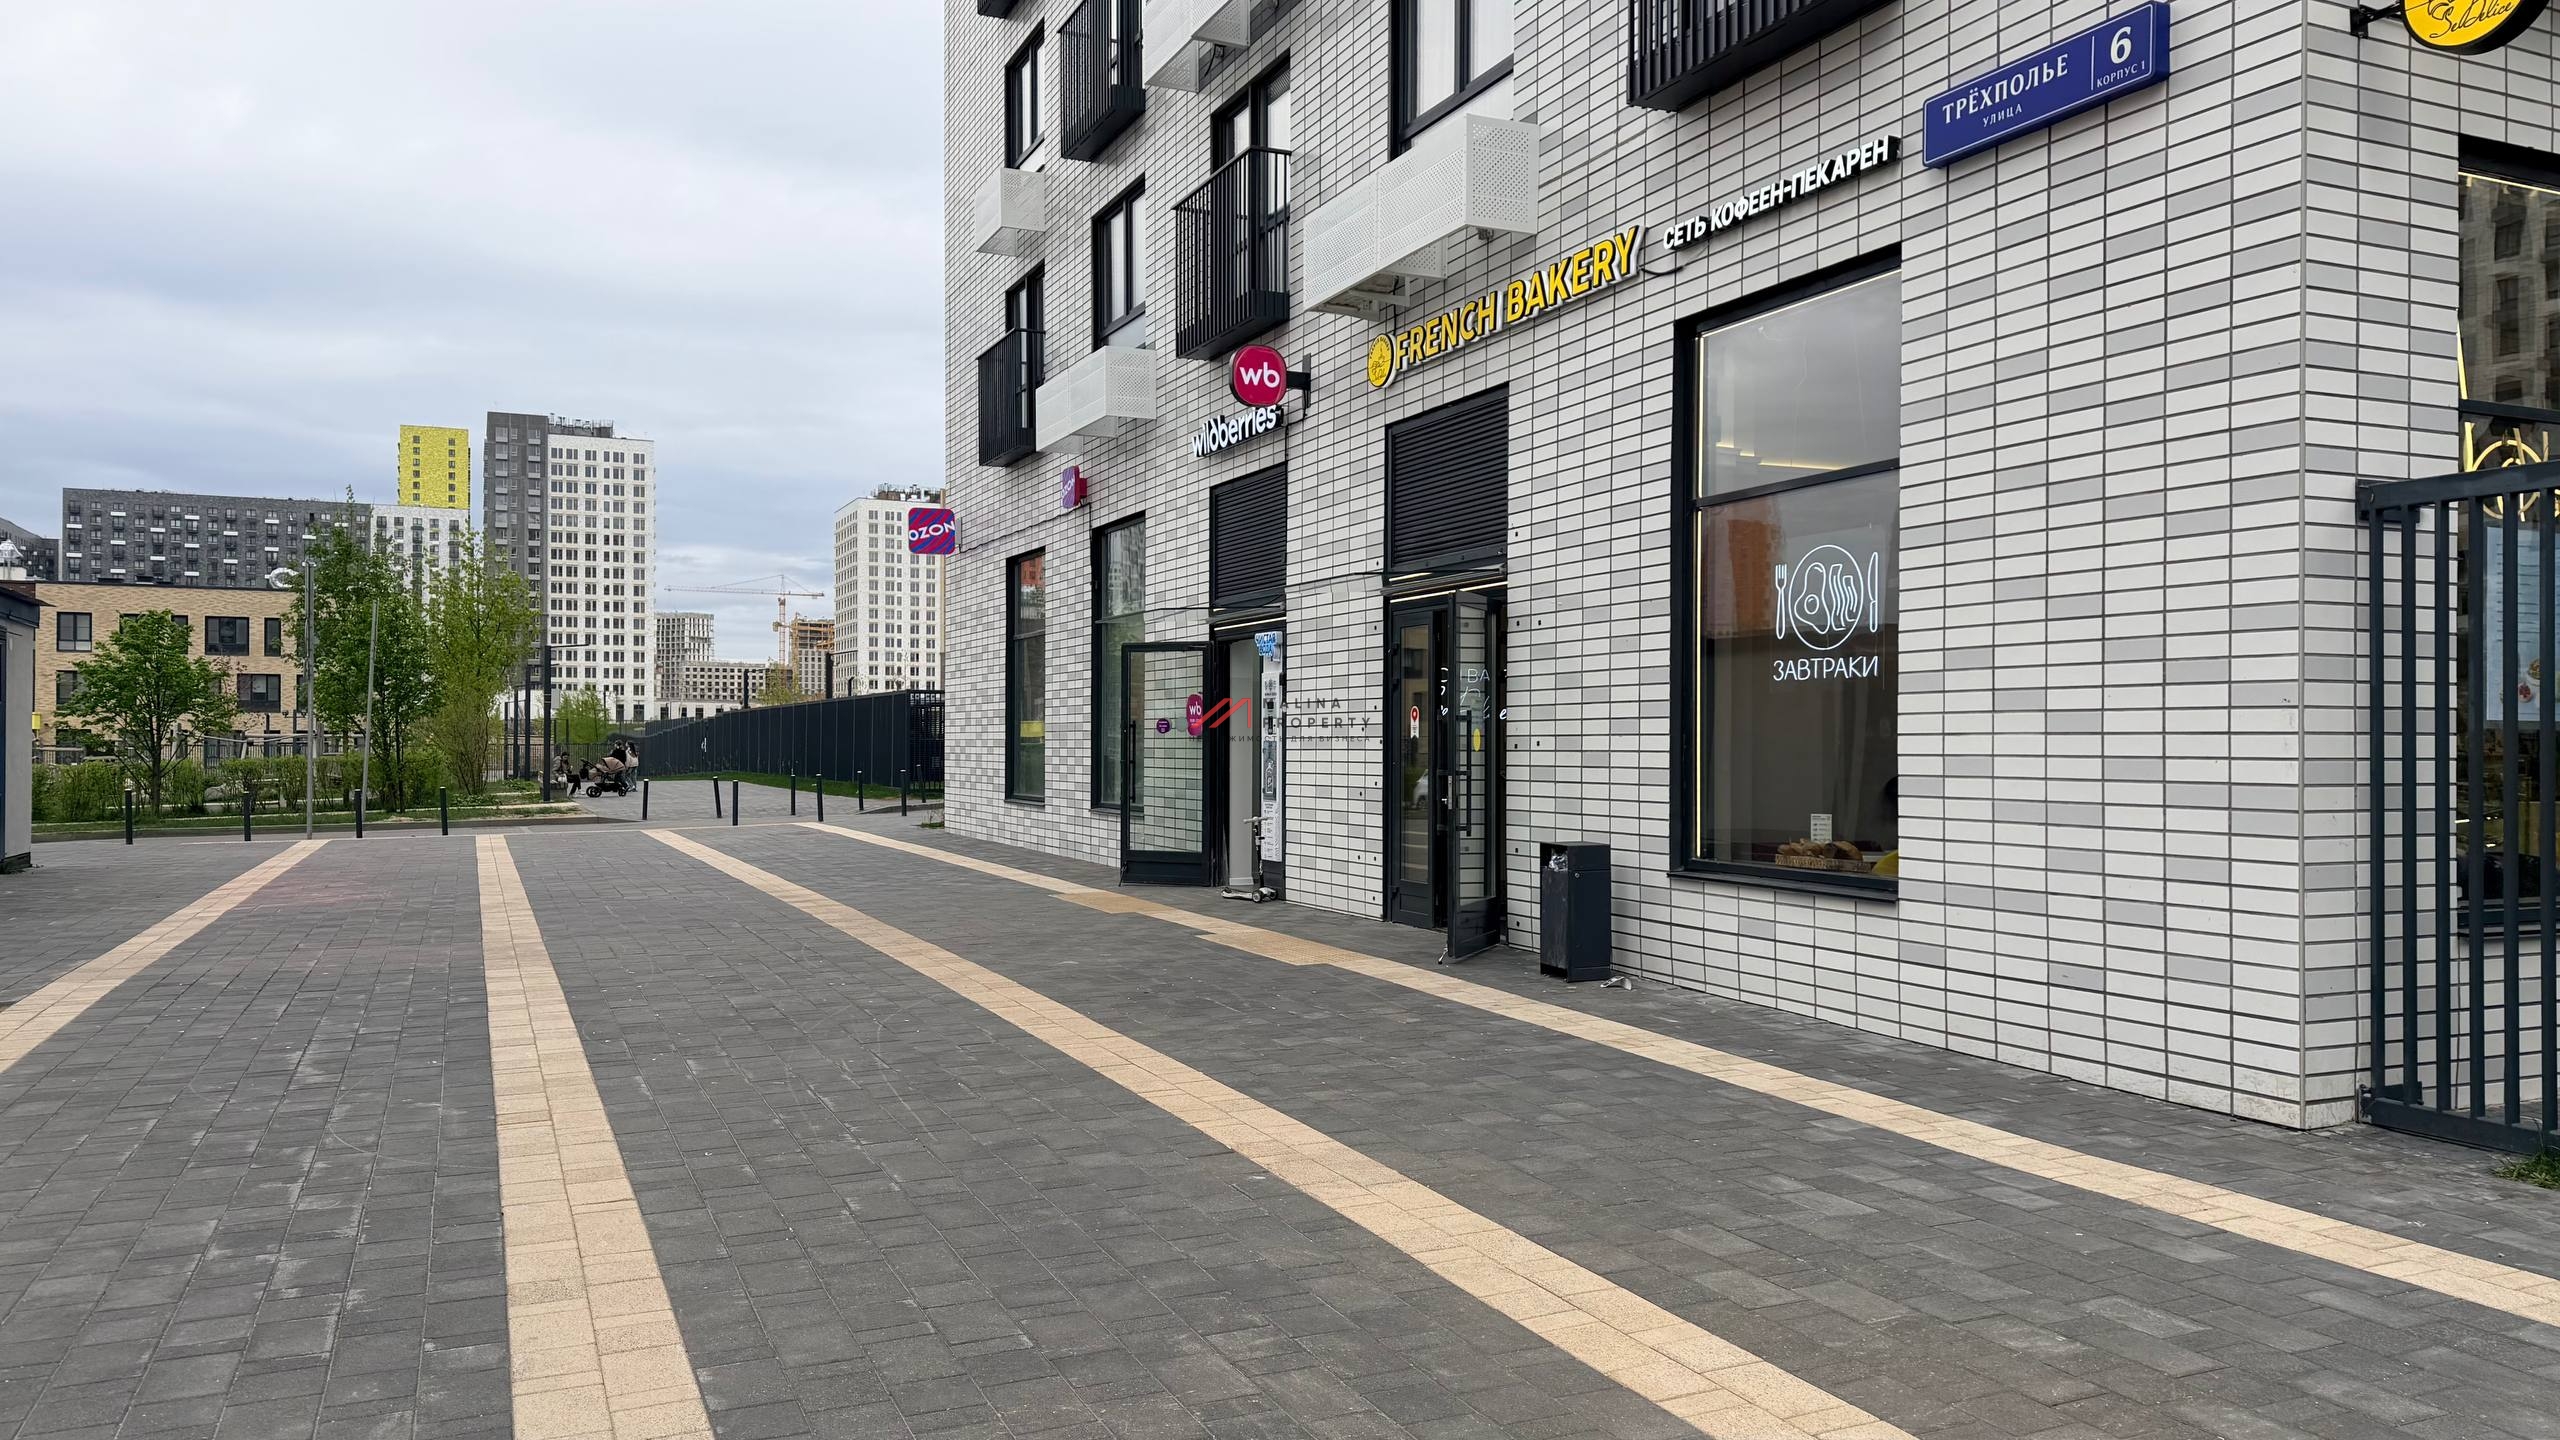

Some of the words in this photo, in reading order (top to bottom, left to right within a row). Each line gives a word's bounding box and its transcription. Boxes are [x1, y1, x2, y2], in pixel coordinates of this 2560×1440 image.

[2110, 26, 2132, 64] 6
[2096, 64, 2138, 88] КОРПУС
[2140, 61, 2146, 71] 1
[1943, 53, 2069, 124] ТРЁХПОЛЬЕ
[1983, 104, 2022, 128] УЛИЦА
[1663, 216, 1706, 249] СЕТЬ
[1710, 135, 1890, 232] КОФЕЕН-ПЕКАРЕН
[1395, 291, 1497, 370] FRENCH
[1506, 225, 1639, 324] BAKERY
[1239, 362, 1280, 388] wb
[1192, 405, 1278, 457] wildberries
[908, 520, 956, 542] OZON
[1773, 655, 1879, 681] ЗАВТРАКИ
[1189, 701, 1202, 716] wb
